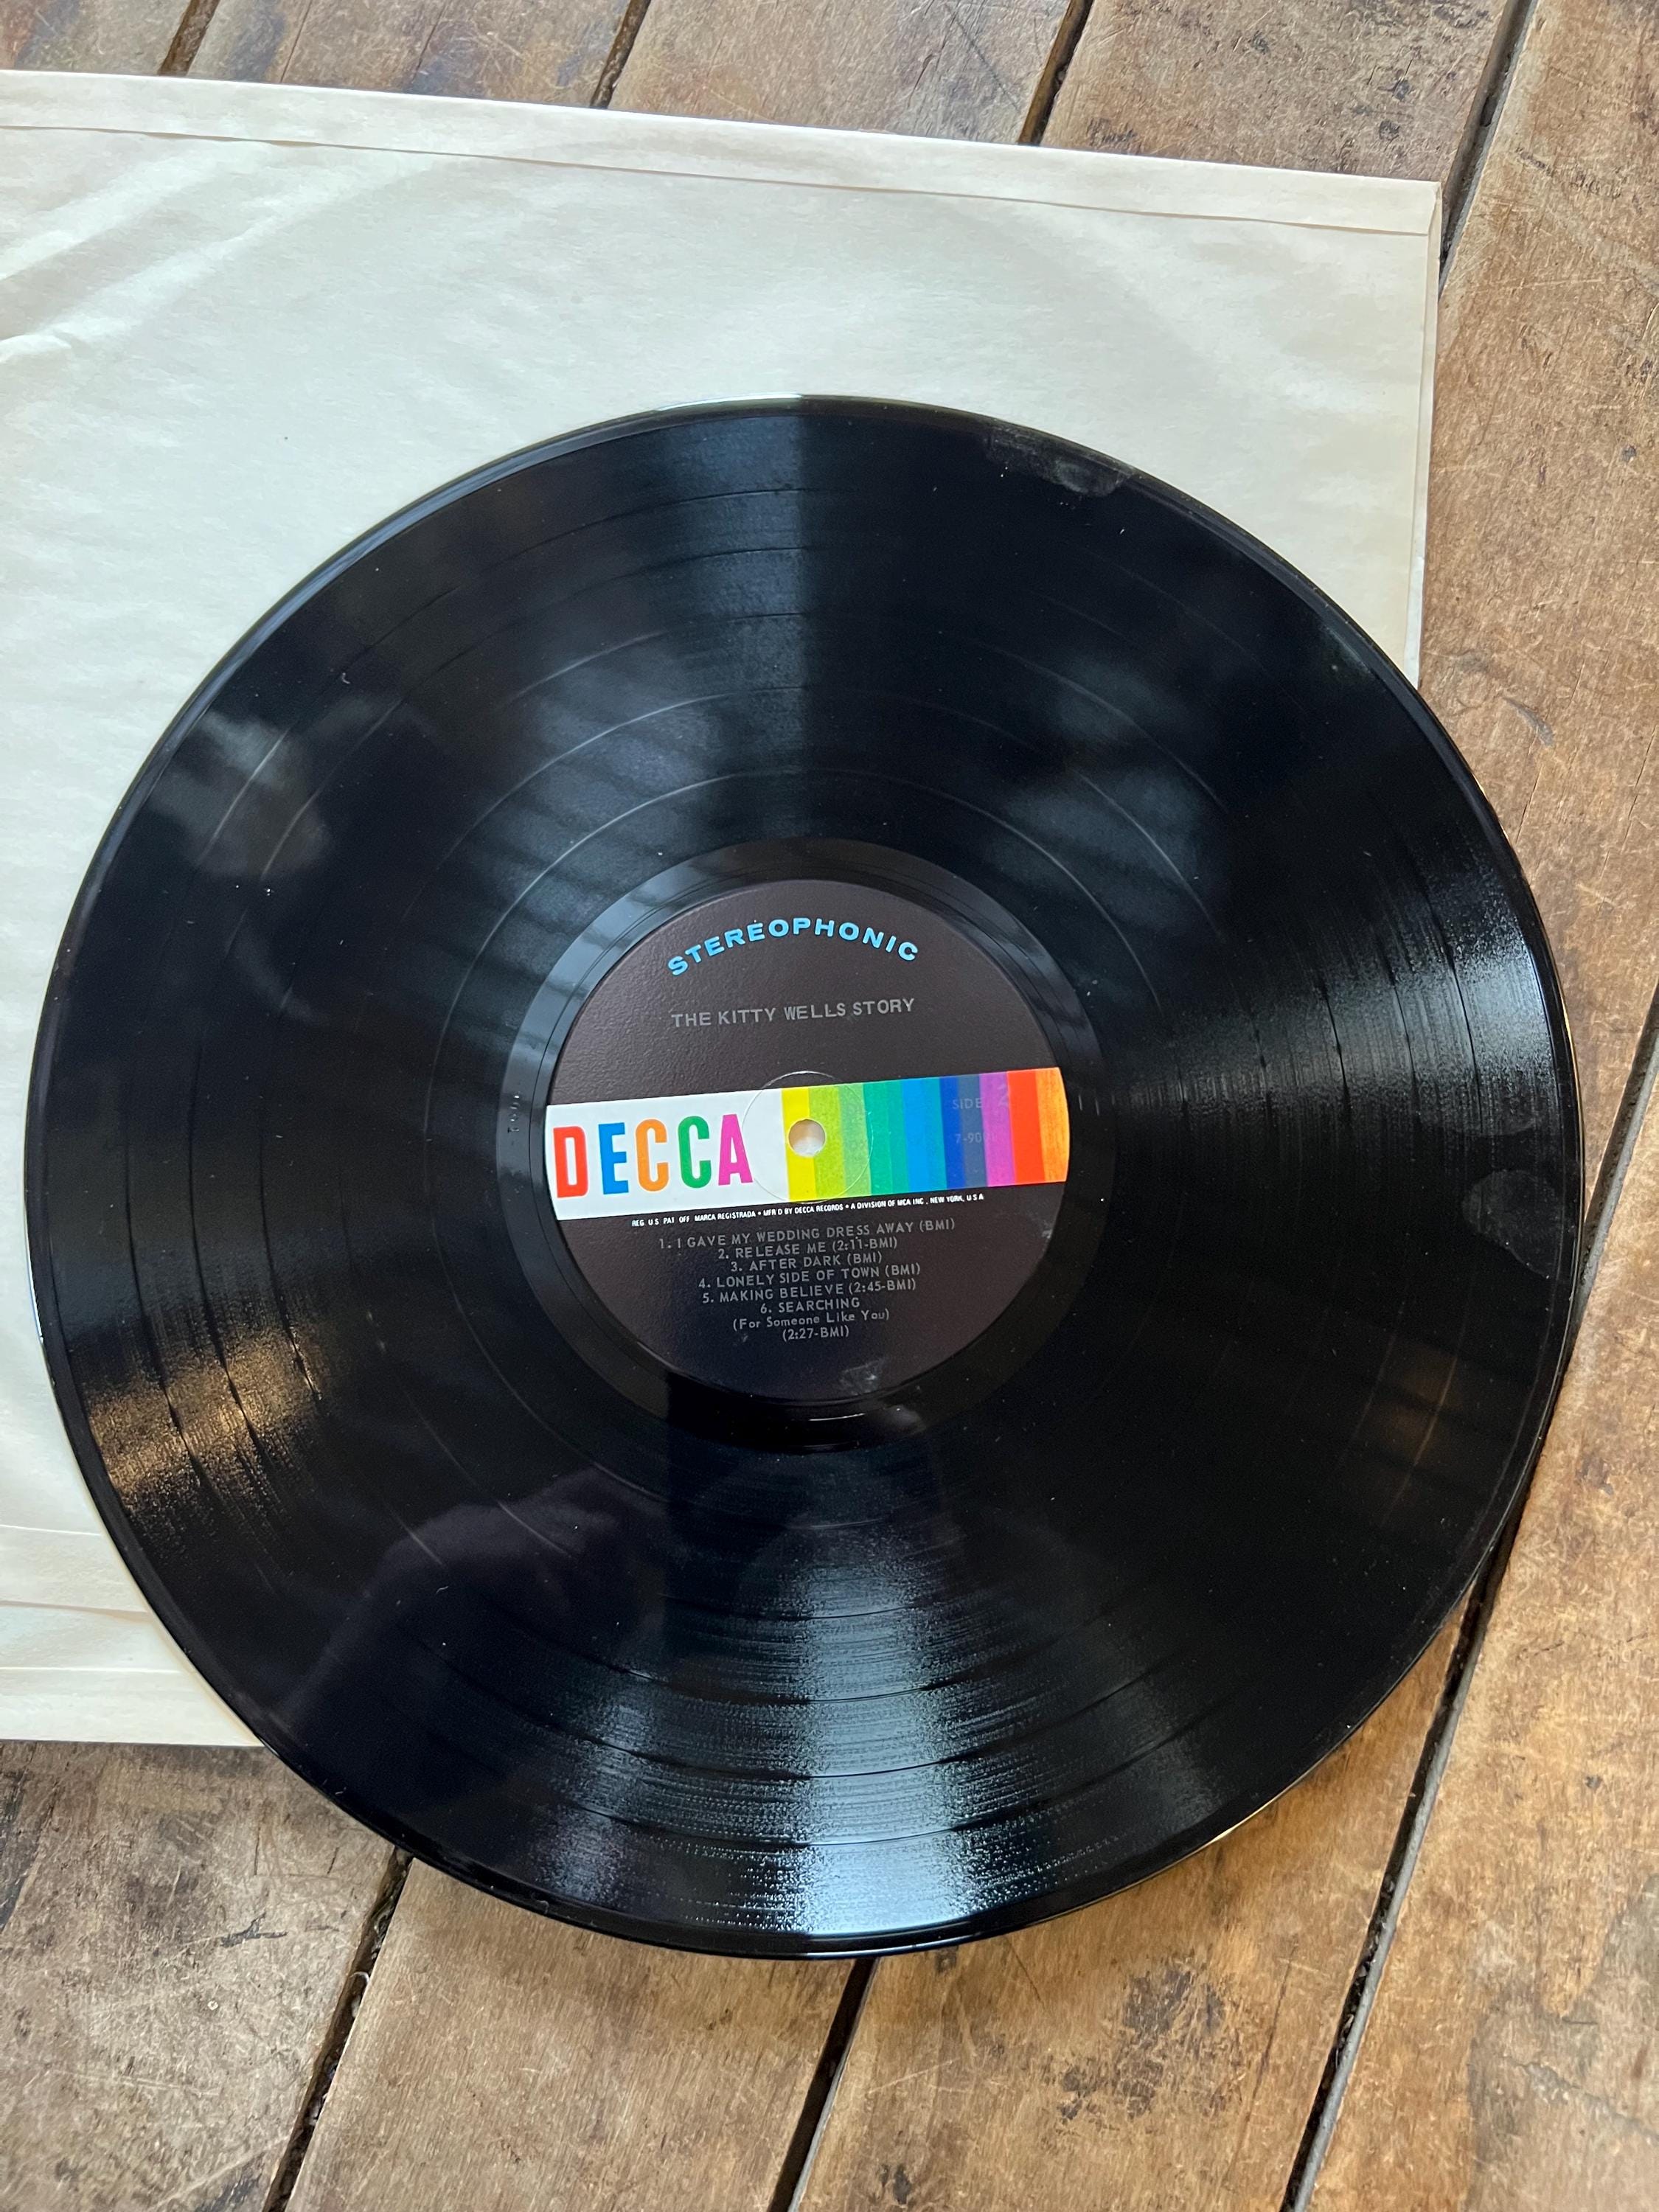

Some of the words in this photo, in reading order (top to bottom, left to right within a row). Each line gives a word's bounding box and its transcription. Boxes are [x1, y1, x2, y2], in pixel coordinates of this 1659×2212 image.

[668, 917, 918, 975] STEREOPHONIC
[671, 1012, 712, 1027] THE
[718, 1007, 776, 1025] KITTY
[784, 1002, 846, 1020] WELLS
[852, 998, 915, 1016] STORY
[952, 1097, 983, 1110] SIDE
[553, 1113, 754, 1198] DECCA
[679, 1215, 689, 1223] OFF
[694, 1211, 716, 1222] MARCA
[717, 1210, 756, 1220] REGISTRADA
[794, 1206, 815, 1214] DECCA
[815, 1203, 844, 1212] RECORDS
[857, 1200, 886, 1209] DIVISION
[897, 1198, 911, 1206] MCA
[659, 1238, 672, 1249] 1.
[687, 1235, 726, 1248] GAVE
[731, 1233, 751, 1245] MY
[757, 1228, 820, 1242] WEDDING
[827, 1225, 870, 1238] DRESS
[876, 1222, 914, 1234] AWAY
[919, 1218, 956, 1232] (BMI)
[718, 1248, 729, 1259] 2.
[735, 1244, 800, 1258] RELEASE
[807, 1242, 826, 1253] ME
[832, 1237, 897, 1253] (2:11-BMI)
[731, 1262, 742, 1272] 3.
[749, 1258, 796, 1271] AFTER
[804, 1255, 841, 1267] DARK
[847, 1251, 882, 1265] (BMI)
[698, 1278, 711, 1288] 4.
[717, 1273, 774, 1287] LONELY
[779, 1270, 809, 1284] SIDE
[816, 1269, 835, 1281] OF
[841, 1267, 880, 1279] TOWN
[885, 1262, 920, 1277] (BMI)
[702, 1293, 714, 1304] 5.
[720, 1289, 773, 1302] MAKING
[779, 1284, 844, 1298] BELIEVE
[849, 1278, 916, 1294] (2:45-BMI)
[760, 1303, 772, 1314] 6.
[779, 1297, 860, 1312] SEARCHING
[733, 1318, 760, 1331] (For
[767, 1315, 820, 1327] Someone
[827, 1311, 855, 1323] Like
[861, 1308, 889, 1321] You)
[782, 1325, 849, 1342] (2:27-BMI)
